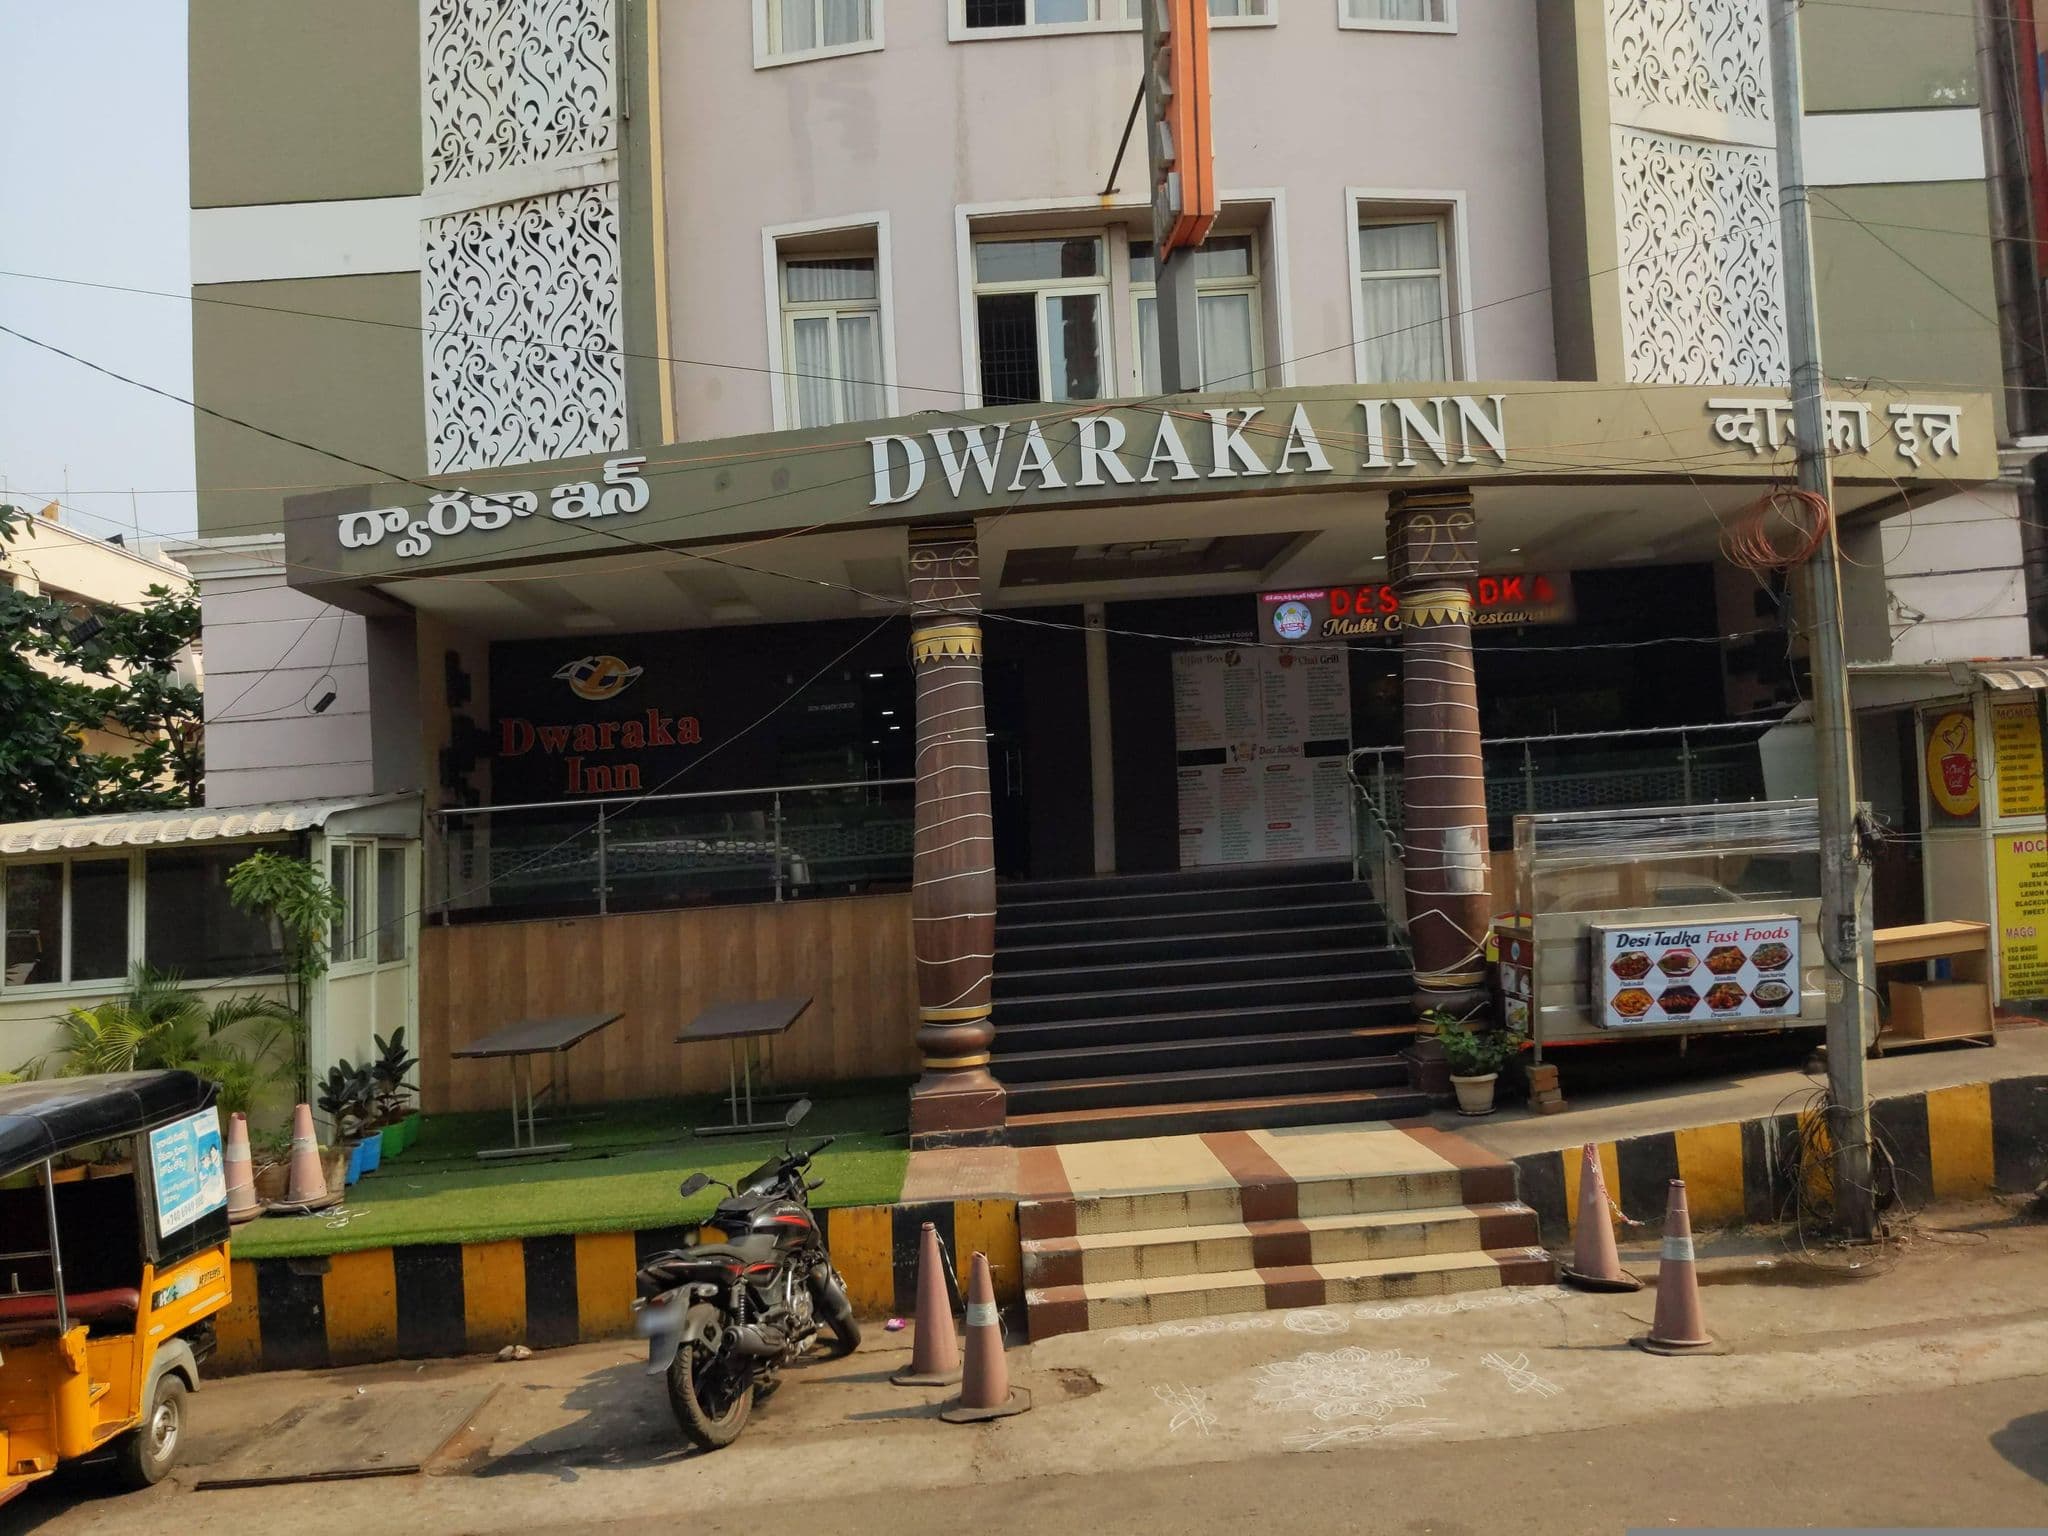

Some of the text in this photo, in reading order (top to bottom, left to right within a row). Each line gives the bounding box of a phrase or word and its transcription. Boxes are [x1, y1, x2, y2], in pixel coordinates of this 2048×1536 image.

[1708, 398, 1871, 455] व्दाका
[865, 394, 1506, 506] DWARAKA INN
[550, 456, 650, 519] ఇన్
[1329, 576, 1554, 616] DES DKA
[1321, 614, 1378, 637] Multi
[1320, 655, 1340, 665] Grill
[500, 708, 702, 756] Dwaraka
[565, 756, 642, 794] Inn
[2020, 889, 2044, 897] LEMON
[1615, 926, 1790, 948] Desi Tadka Fast Foods
[2006, 927, 2037, 938] MAGGI
